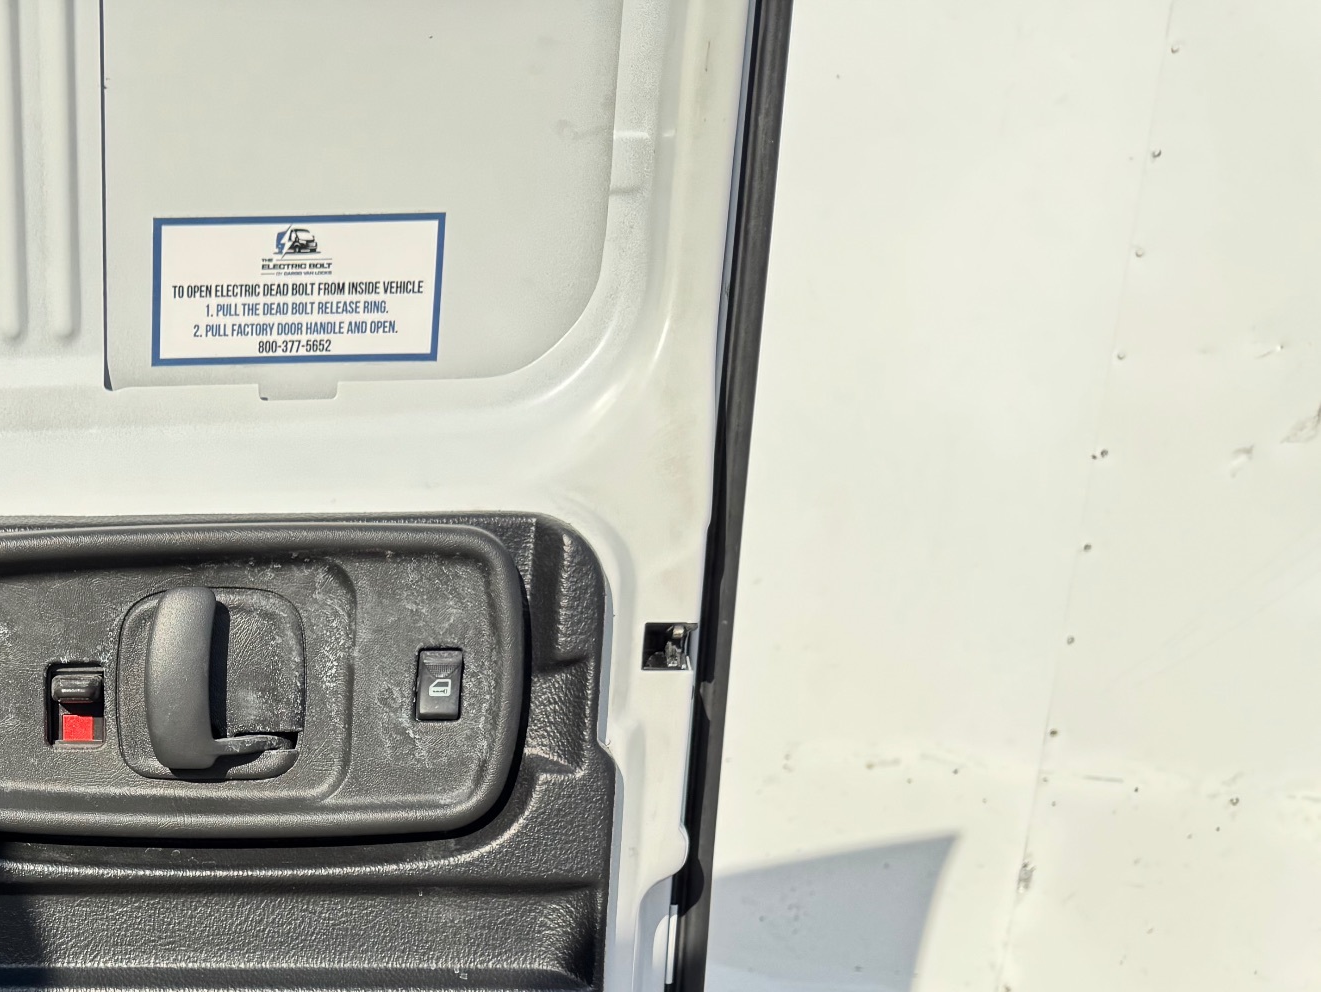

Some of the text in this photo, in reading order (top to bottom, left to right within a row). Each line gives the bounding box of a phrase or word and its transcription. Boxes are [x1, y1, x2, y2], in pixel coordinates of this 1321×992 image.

[172, 280, 424, 299] TO OPEN ELECTRIC DEAD BOLT FROM INSIDE VEHICLE
[206, 300, 389, 318] 1. PULL THE DEAD BOLT RELEASE RING.
[193, 320, 398, 338] 2. PULL FACTORY DOOR HANDLE AND OPEN.
[258, 339, 332, 354] 800-377-5652
